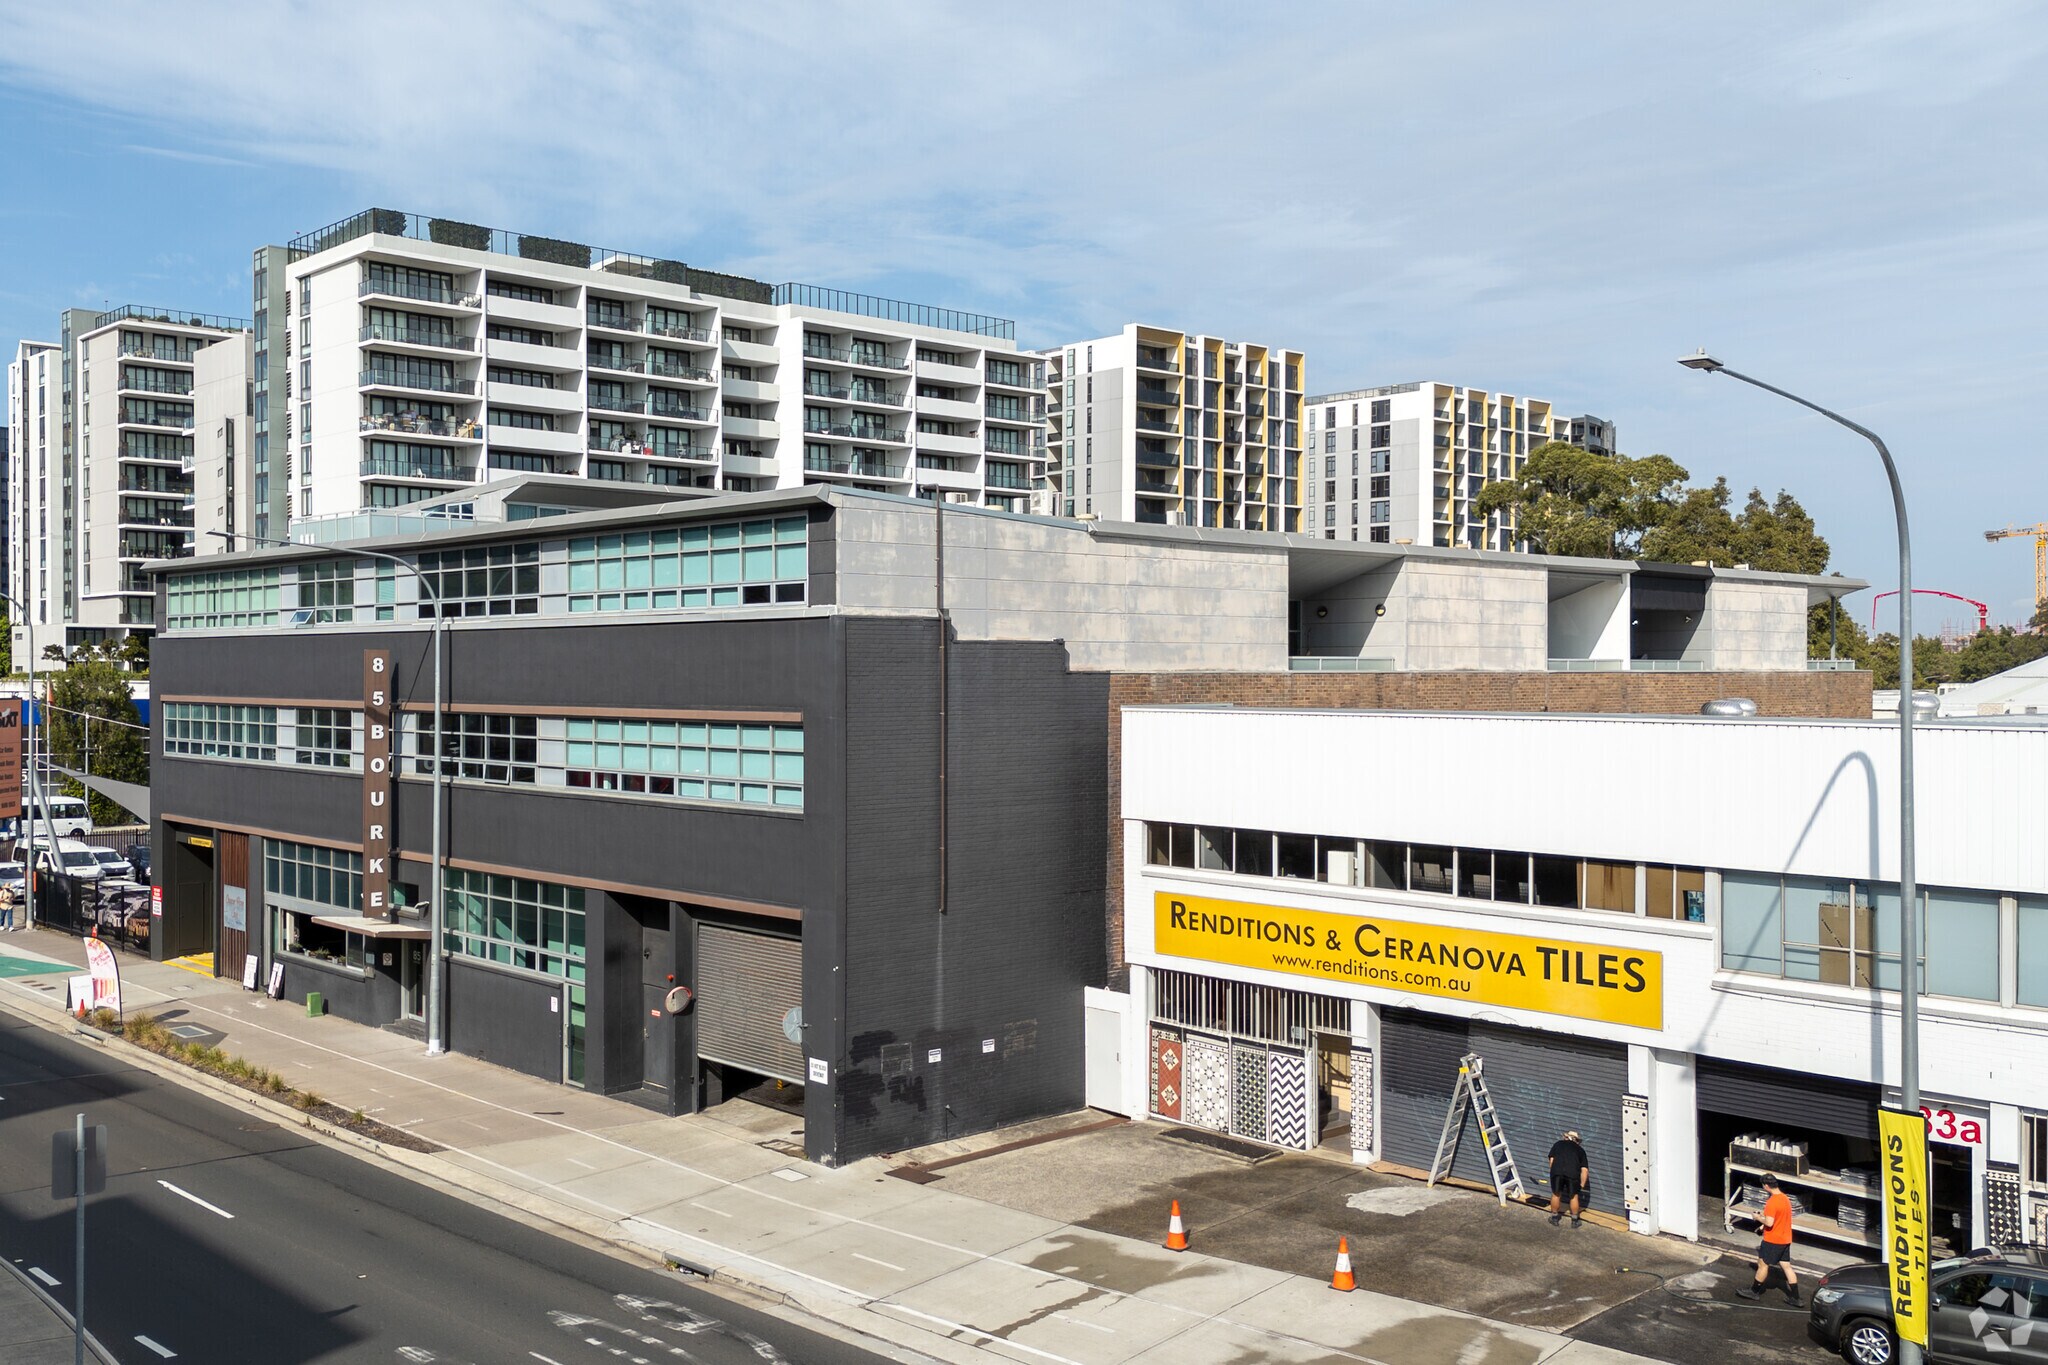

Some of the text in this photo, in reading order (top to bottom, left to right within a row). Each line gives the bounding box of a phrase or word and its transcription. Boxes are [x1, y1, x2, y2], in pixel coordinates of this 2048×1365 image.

[1170, 900, 1646, 993] RENDITIONS & CERANOVA TILES
[1272, 953, 1471, 992] www.renditions.com.au
[1887, 1134, 1913, 1318] RENDITIONS
